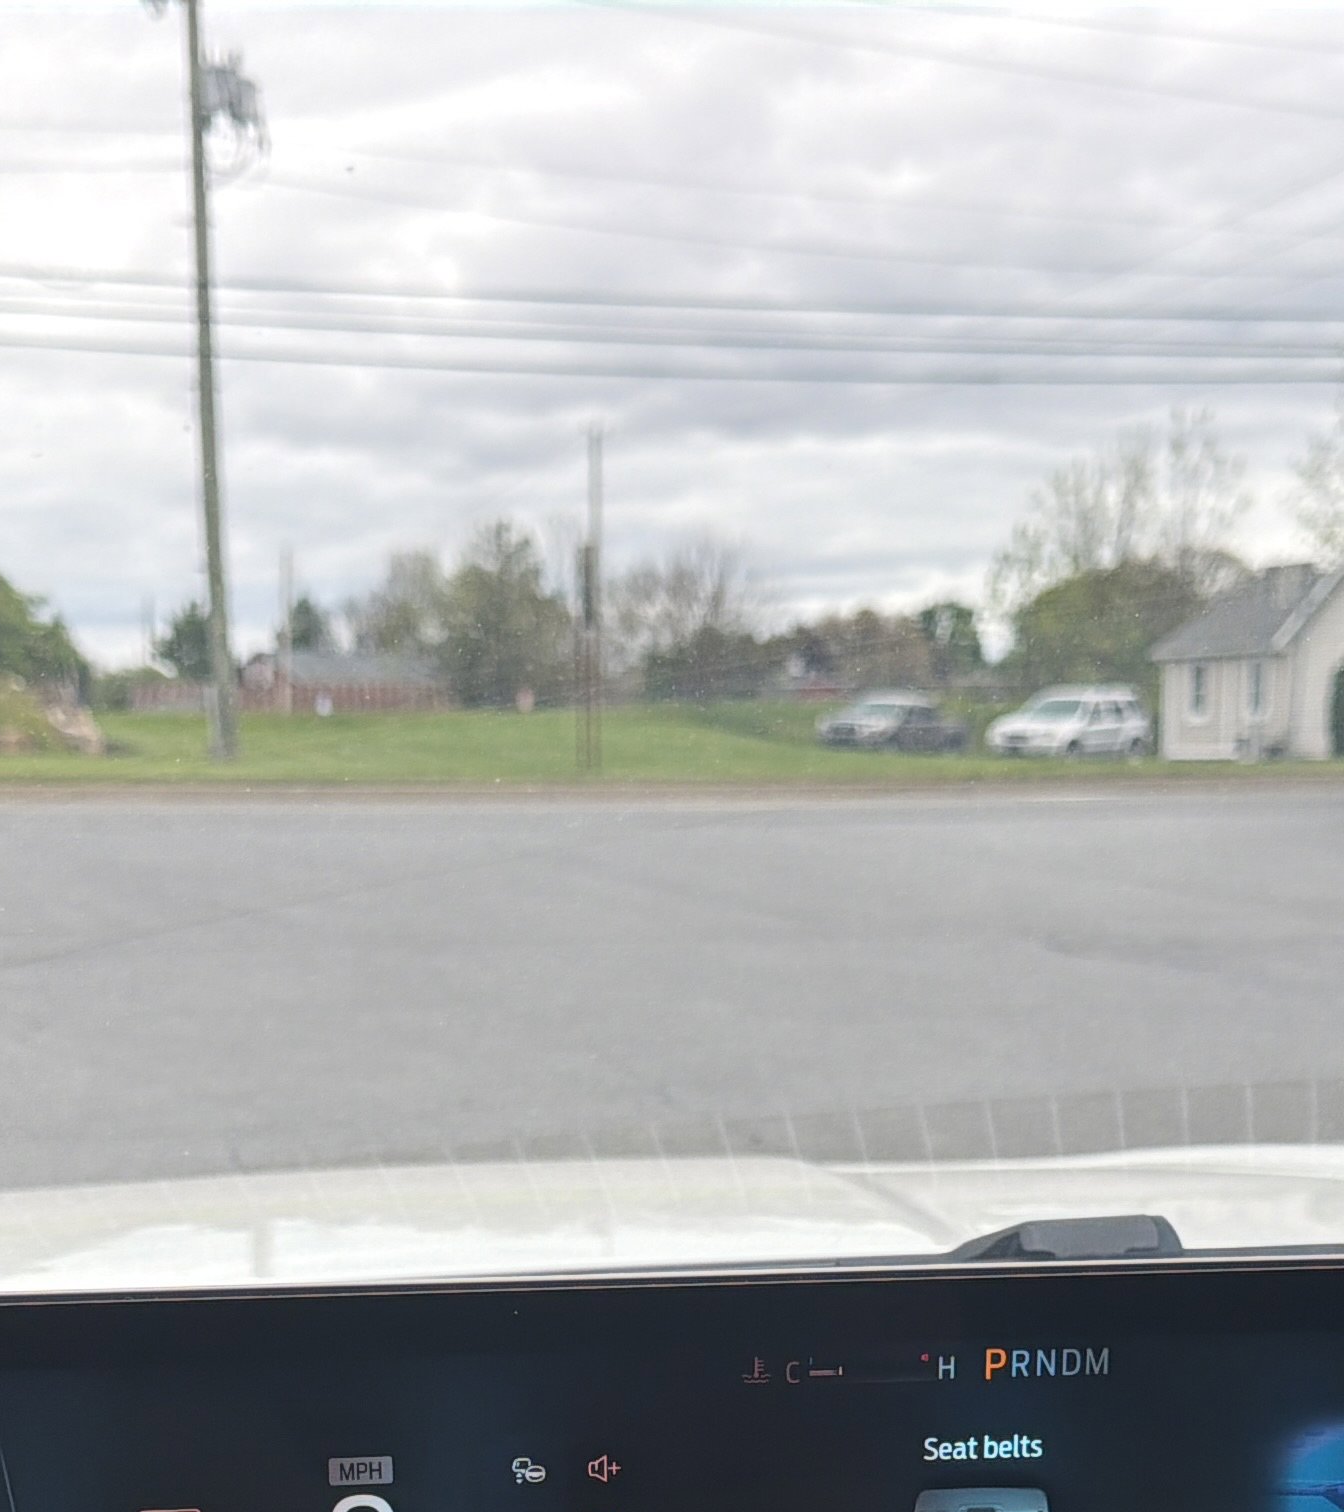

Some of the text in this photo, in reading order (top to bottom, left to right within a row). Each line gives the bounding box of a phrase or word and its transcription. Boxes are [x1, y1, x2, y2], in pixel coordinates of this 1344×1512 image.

[785, 1361, 800, 1384] C
[938, 1355, 955, 1380] H
[923, 1434, 1043, 1461] Seat belts
[339, 1460, 383, 1482] MPH
